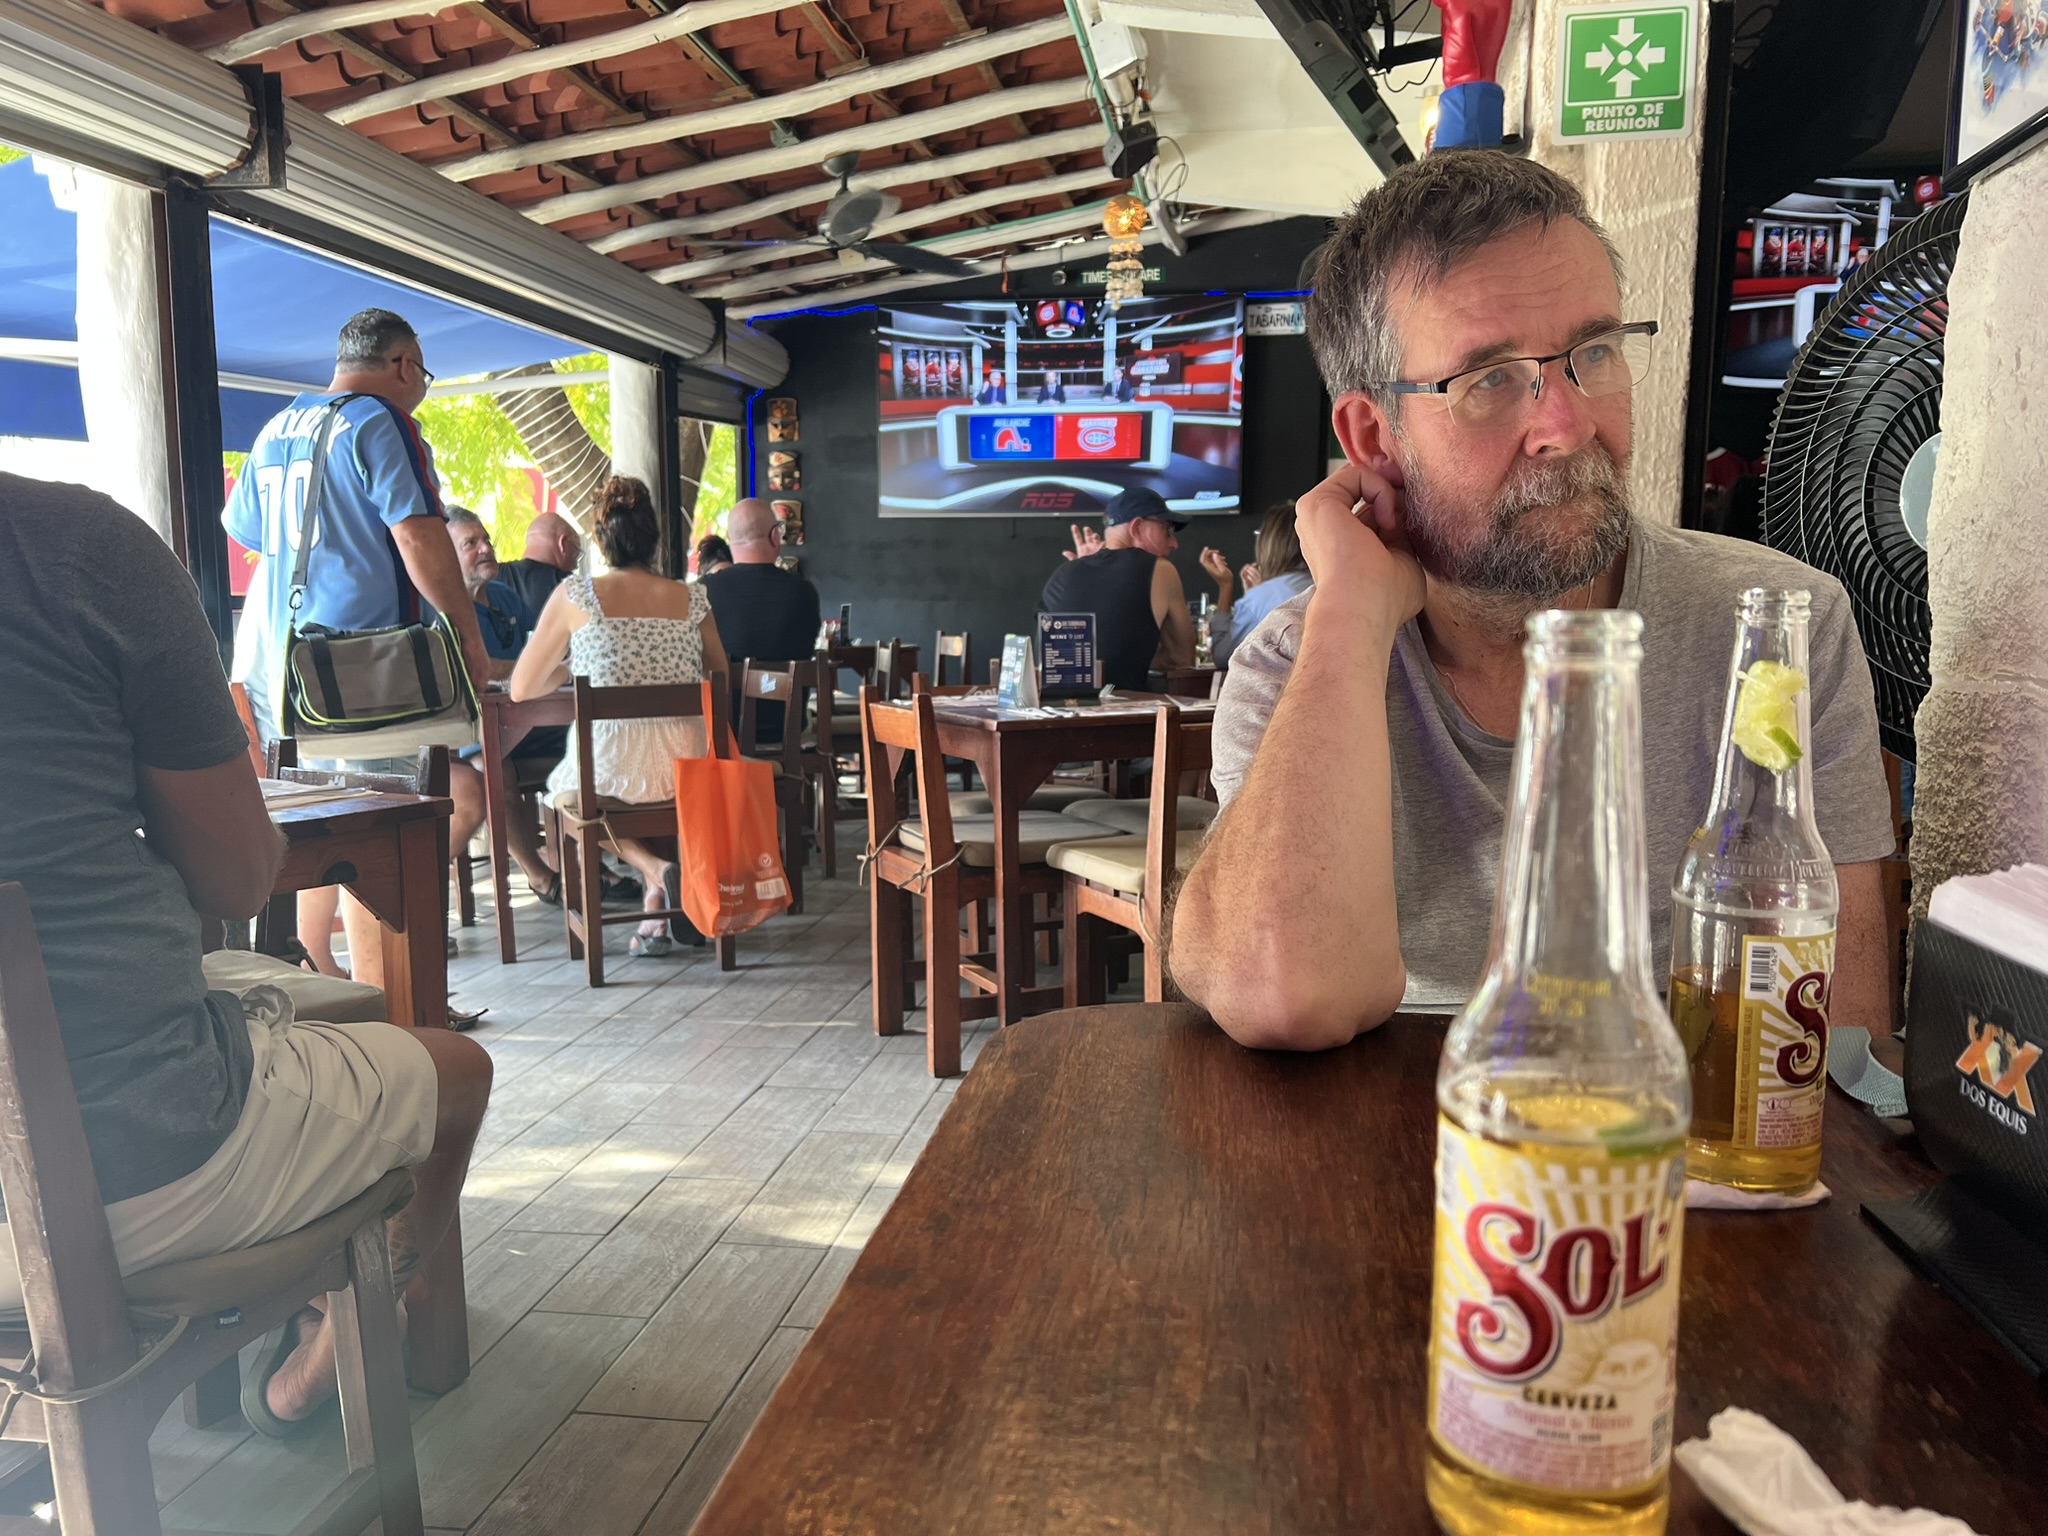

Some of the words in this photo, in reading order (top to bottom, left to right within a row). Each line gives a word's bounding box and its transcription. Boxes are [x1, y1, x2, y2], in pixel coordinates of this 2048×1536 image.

[1582, 105, 1638, 119] PUNTO
[1643, 102, 1664, 115] DE
[1585, 116, 1660, 132] REUNION
[1082, 271, 1112, 284] TIMES
[257, 459, 321, 556] 70
[1960, 1077, 1987, 1108] DOS
[1987, 1095, 2028, 1135] EQUIS
[1522, 1386, 1618, 1410] CERVEZA
